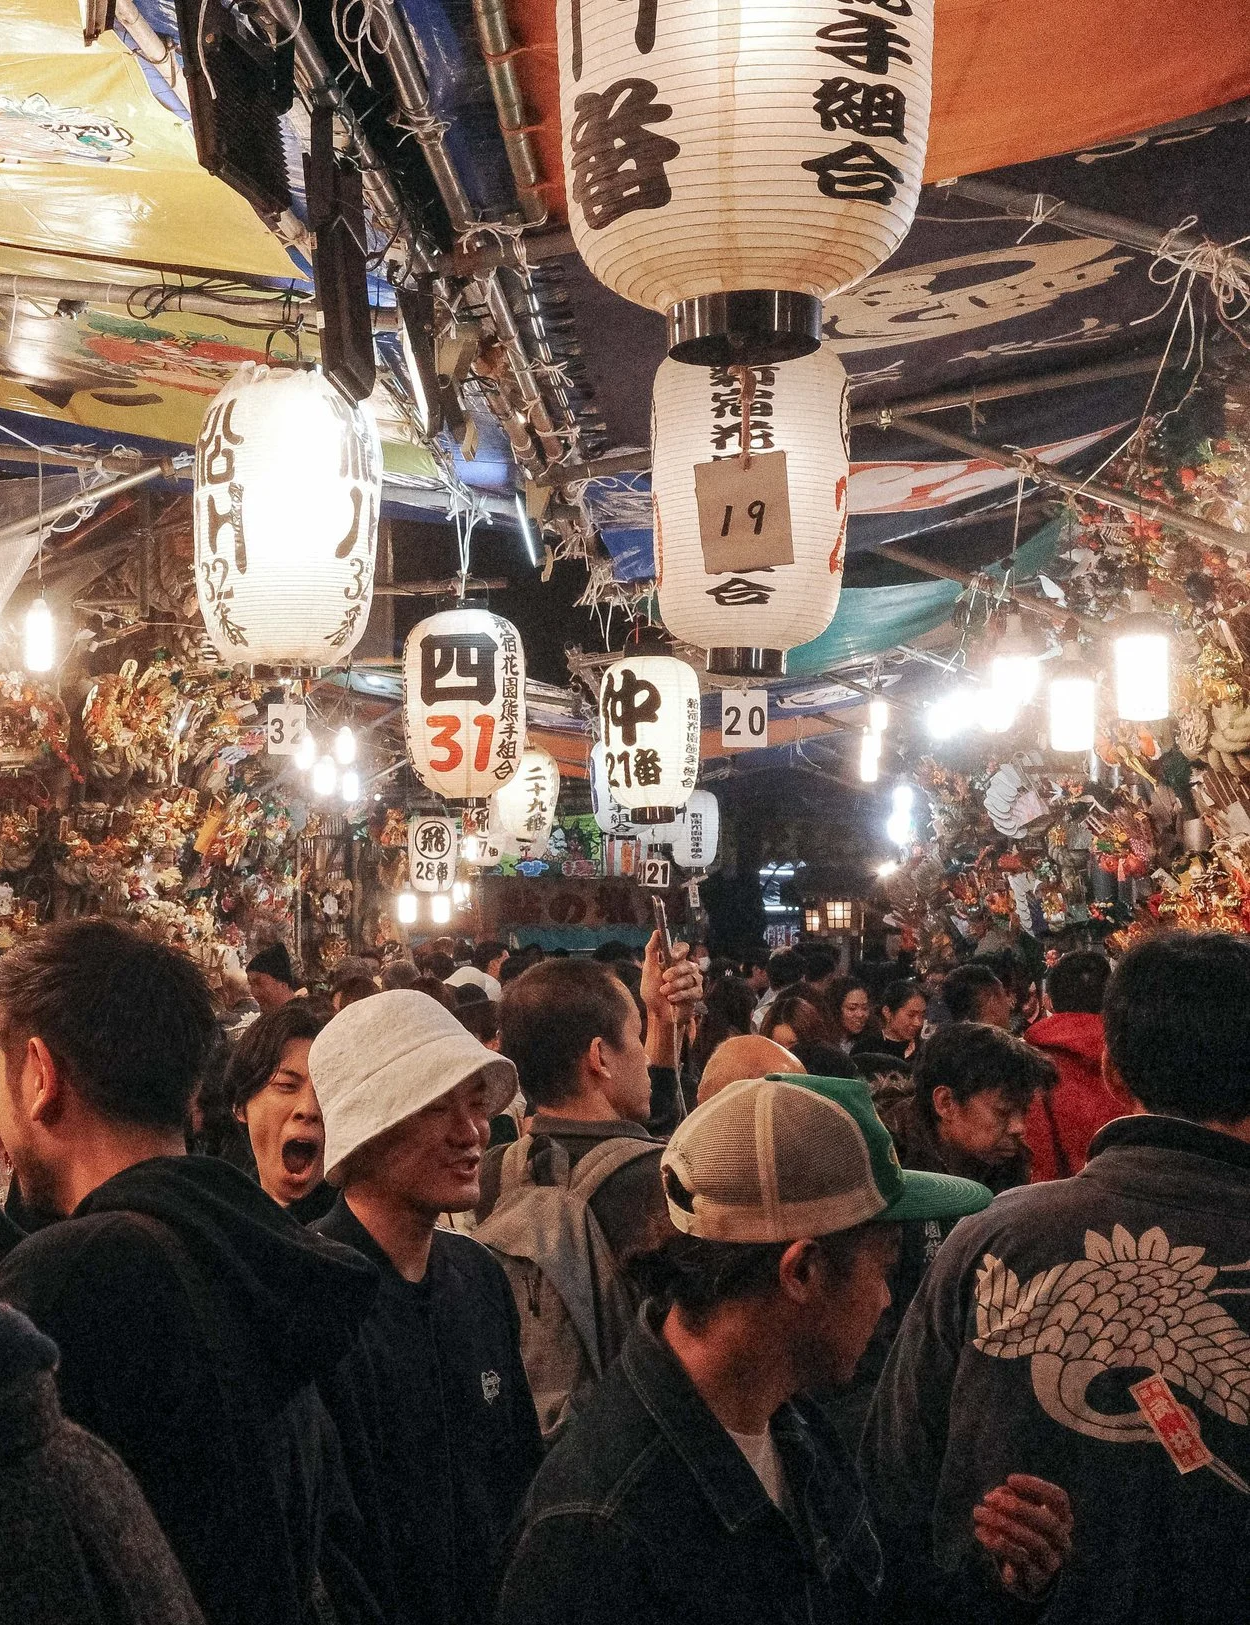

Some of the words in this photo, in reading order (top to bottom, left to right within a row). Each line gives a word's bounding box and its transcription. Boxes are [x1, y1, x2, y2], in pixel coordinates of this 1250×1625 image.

[720, 499, 766, 537] 19
[420, 631, 499, 707] 四
[489, 615, 521, 780] 新宿花園熊手組合
[601, 668, 662, 748] 仲
[724, 705, 766, 736] 20
[426, 713, 496, 773] 31
[605, 748, 663, 789] 21番
[523, 765, 548, 832] 二十九番
[647, 862, 669, 885] 21
